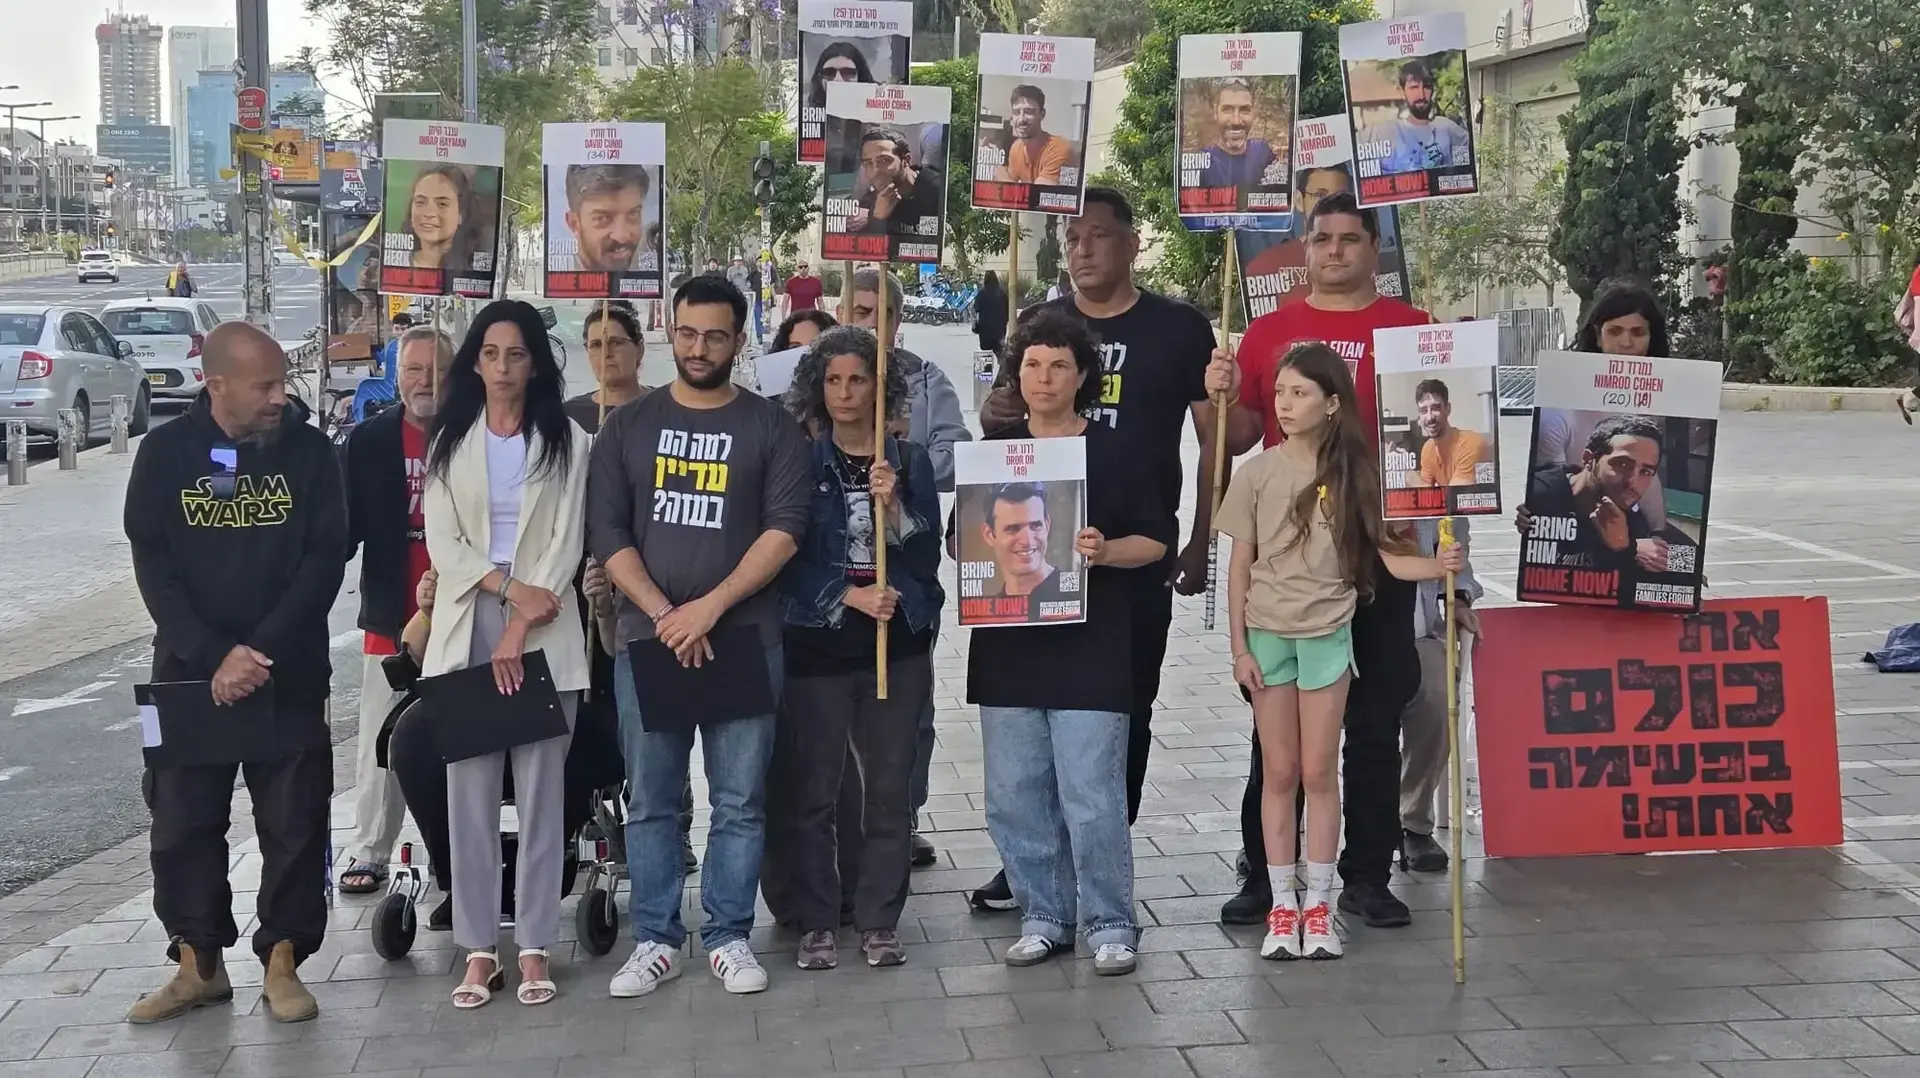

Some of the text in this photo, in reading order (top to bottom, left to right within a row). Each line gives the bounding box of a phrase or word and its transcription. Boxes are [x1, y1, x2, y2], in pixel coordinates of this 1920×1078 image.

[834, 8, 846, 19] (25)
[1387, 34, 1401, 46] GUY
[803, 107, 826, 122] BRIN
[802, 123, 821, 138] HIM
[1300, 134, 1336, 151] NIMRODI
[1358, 140, 1391, 160] BRING
[977, 146, 1005, 164] BRING
[1182, 152, 1211, 169] BRING
[1359, 160, 1381, 178] HIM
[1181, 170, 1200, 187] HIM
[826, 198, 859, 216] BRING
[826, 216, 847, 233] HIM
[385, 232, 414, 250] BRING
[1246, 273, 1291, 297] BRING
[1250, 295, 1278, 318] HIM
[1421, 354, 1437, 367] (27)
[1608, 360, 1652, 376] נמרוד כהן
[1594, 374, 1664, 392] NIMROD COHEN
[1603, 391, 1631, 407] (20)
[657, 429, 733, 461] למה הם
[1006, 454, 1035, 466] DROR OR
[1385, 452, 1416, 470] BRING
[655, 456, 729, 492] עדיין
[1386, 470, 1406, 489] HIM
[181, 475, 292, 501] SAM
[181, 499, 292, 527] WARS
[653, 489, 725, 529] בעזה?
[1528, 515, 1578, 541] BRING
[1526, 540, 1557, 564] HIM
[962, 561, 995, 579] BRING
[962, 579, 983, 597] HIM
[1524, 567, 1620, 596] HOME NOW!
[962, 596, 1028, 617] HOME NOW!
[1635, 590, 1694, 605] FAMILIES FORUM
[1678, 609, 1780, 652] את
[1542, 659, 1785, 734] כולם
[1528, 740, 1792, 789] בפעימה
[1622, 792, 1793, 839] אחת!
